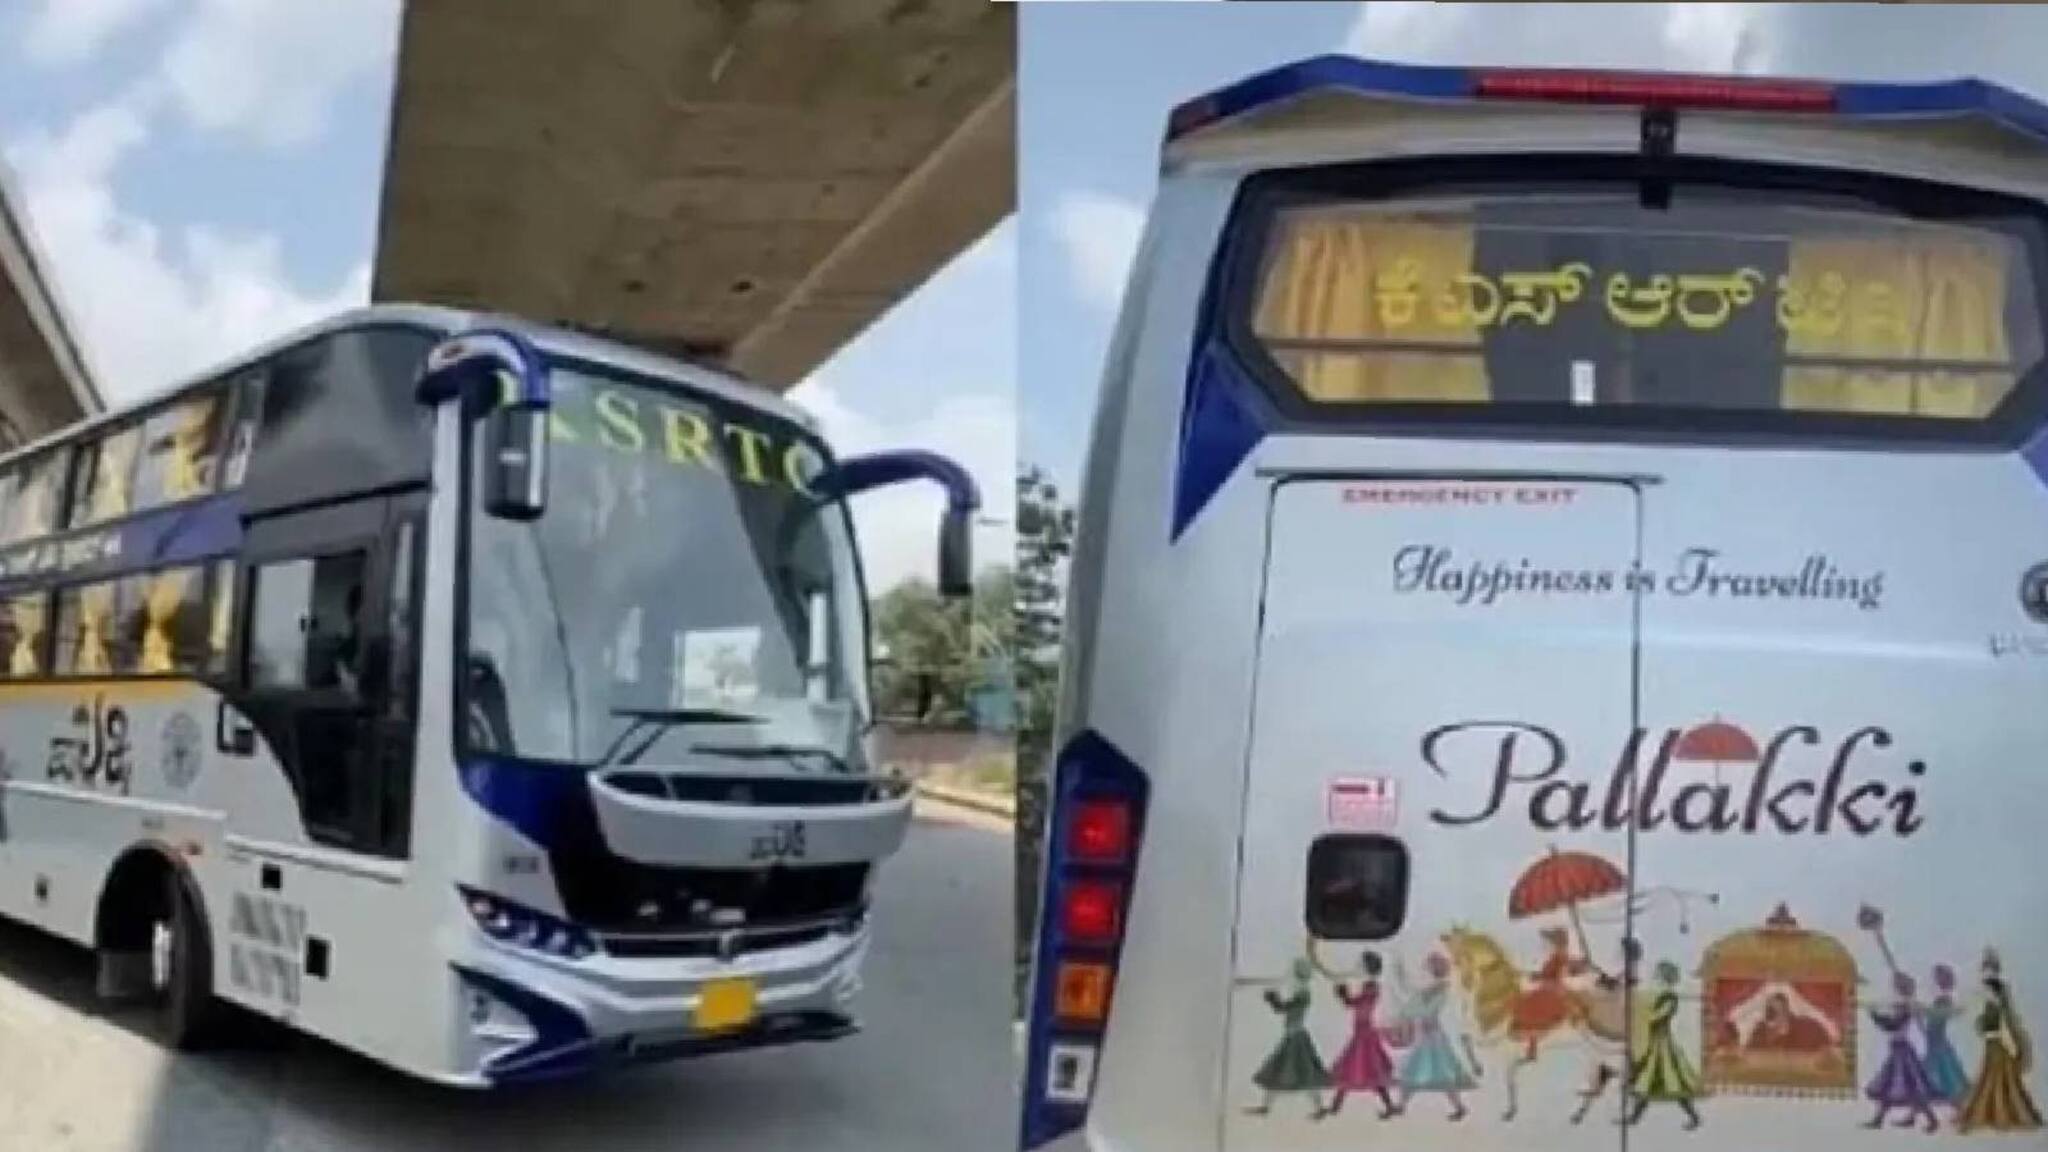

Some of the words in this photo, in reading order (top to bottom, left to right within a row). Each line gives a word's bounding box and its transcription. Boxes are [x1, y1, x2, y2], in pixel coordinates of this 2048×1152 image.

[1393, 544, 1614, 604] Happiness
[1625, 561, 1656, 592] is
[1666, 547, 1884, 609] Travelling
[1420, 720, 1928, 836] Pallakki
